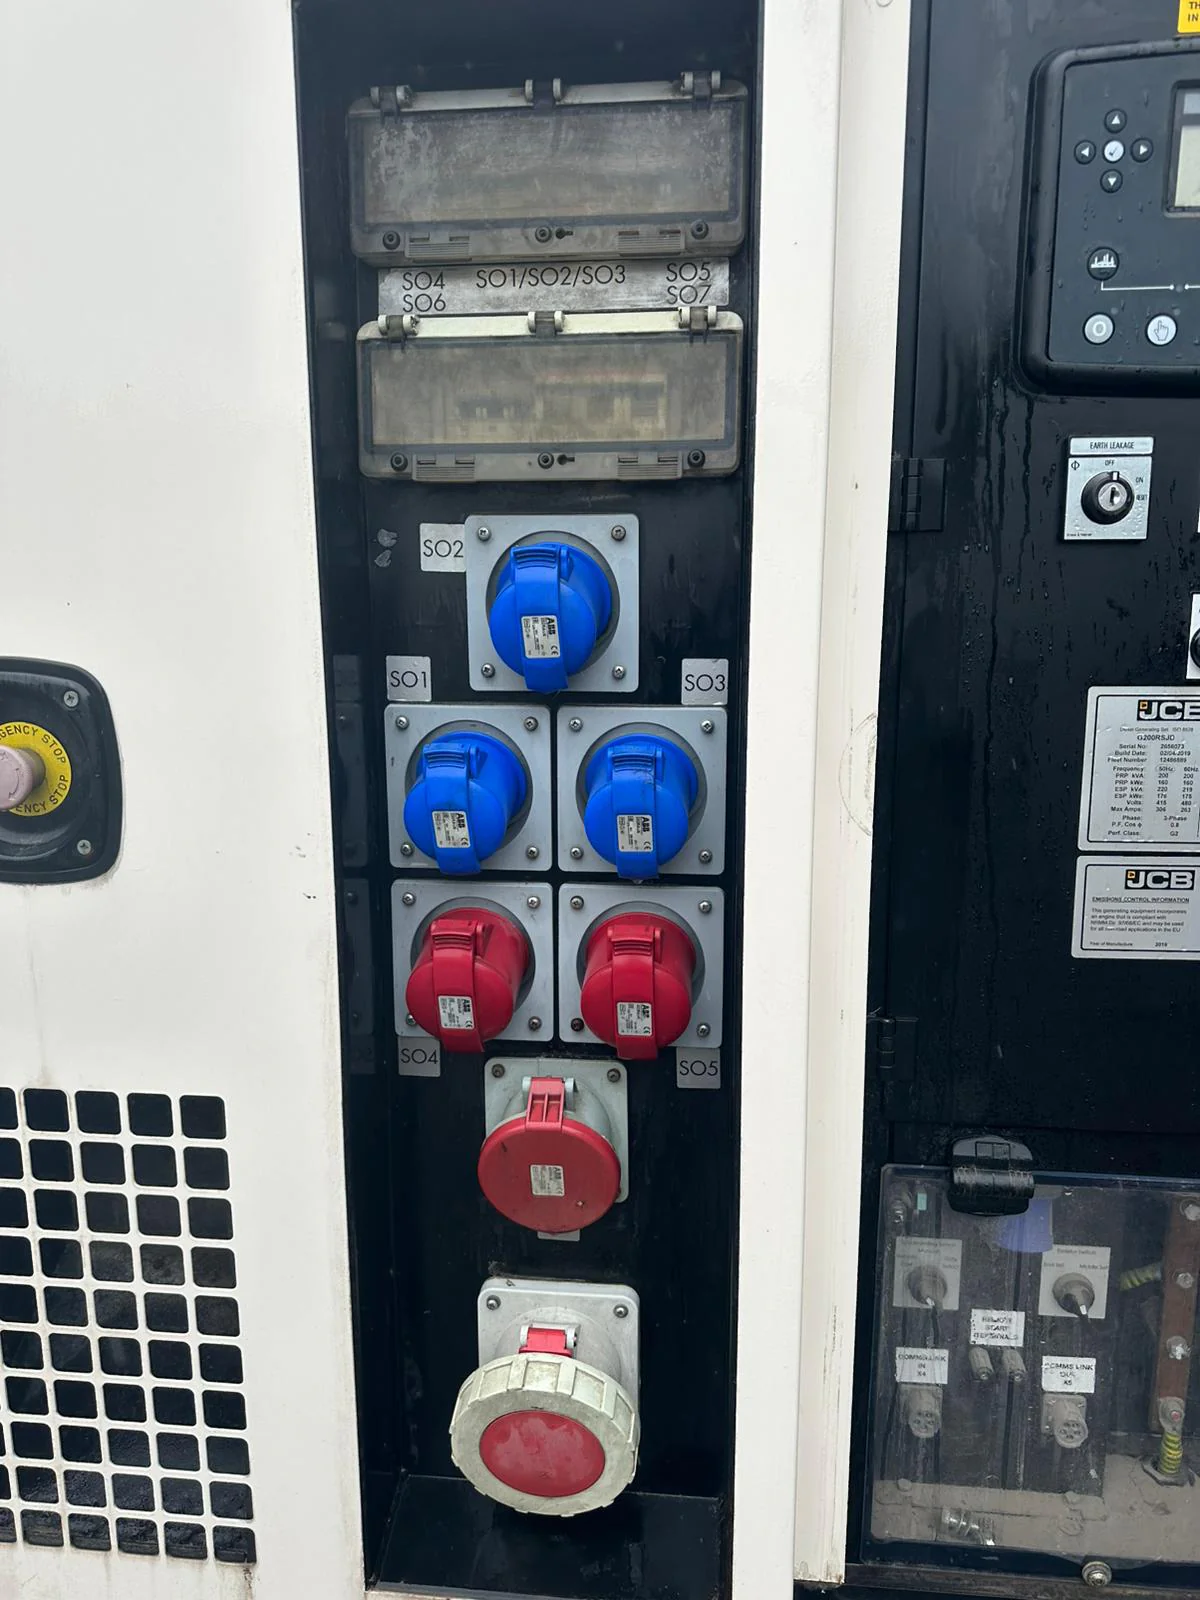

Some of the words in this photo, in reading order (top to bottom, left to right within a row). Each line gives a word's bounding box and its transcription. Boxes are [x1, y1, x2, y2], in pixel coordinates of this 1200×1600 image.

[1188, 13, 1198, 22] IN
[402, 271, 446, 290] SO4
[476, 264, 626, 288] SO1/SO2/SO3
[666, 262, 711, 282] SO5
[402, 293, 446, 312] SO6
[666, 284, 712, 305] SO7
[423, 539, 464, 558] SO2
[390, 670, 426, 688] SO1
[684, 674, 726, 692] SO3
[1139, 701, 1200, 720] JCB
[0, 725, 38, 738] GENCY
[41, 734, 66, 764] STOP
[50, 774, 68, 804] STOP
[1126, 870, 1193, 889] JCB
[400, 1048, 438, 1064] SO4
[680, 1060, 718, 1076] SO5
